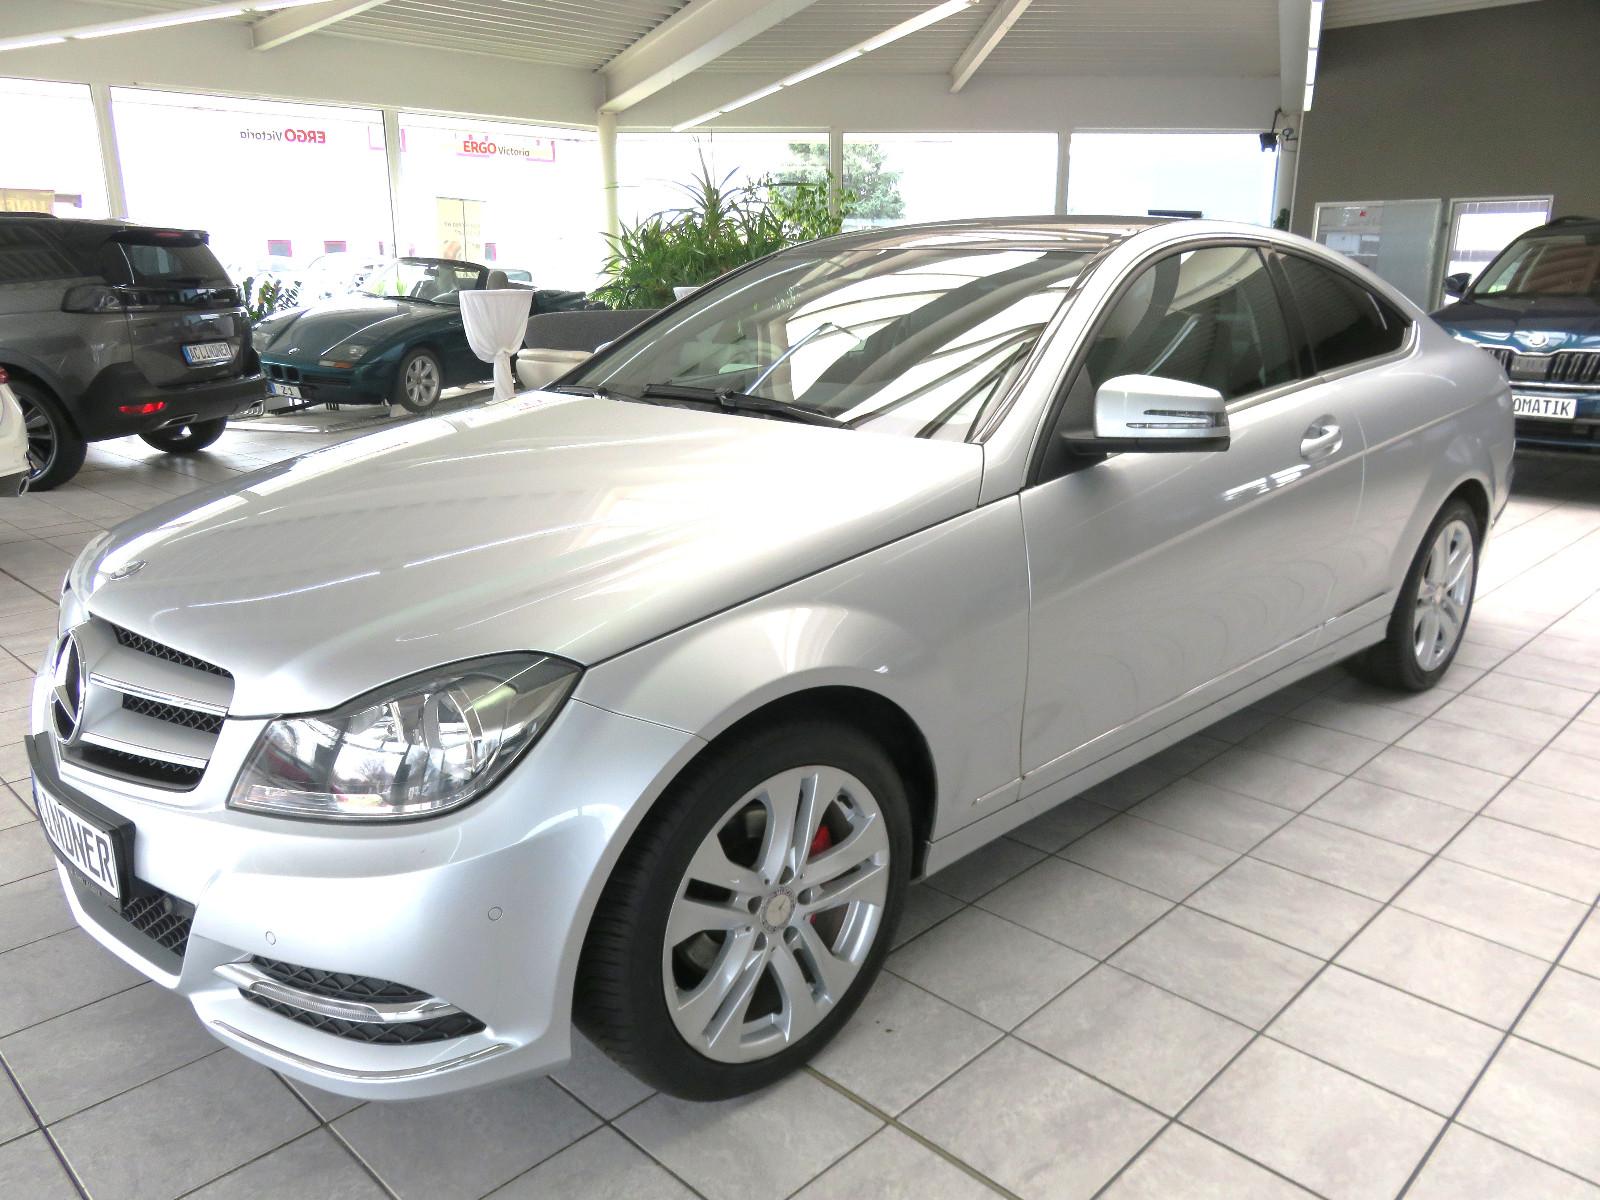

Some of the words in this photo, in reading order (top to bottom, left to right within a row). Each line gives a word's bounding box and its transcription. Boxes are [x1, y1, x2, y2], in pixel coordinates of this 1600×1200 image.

[463, 140, 497, 154] ERGO
[497, 146, 530, 157] Victoria
[280, 385, 294, 396] Z1
